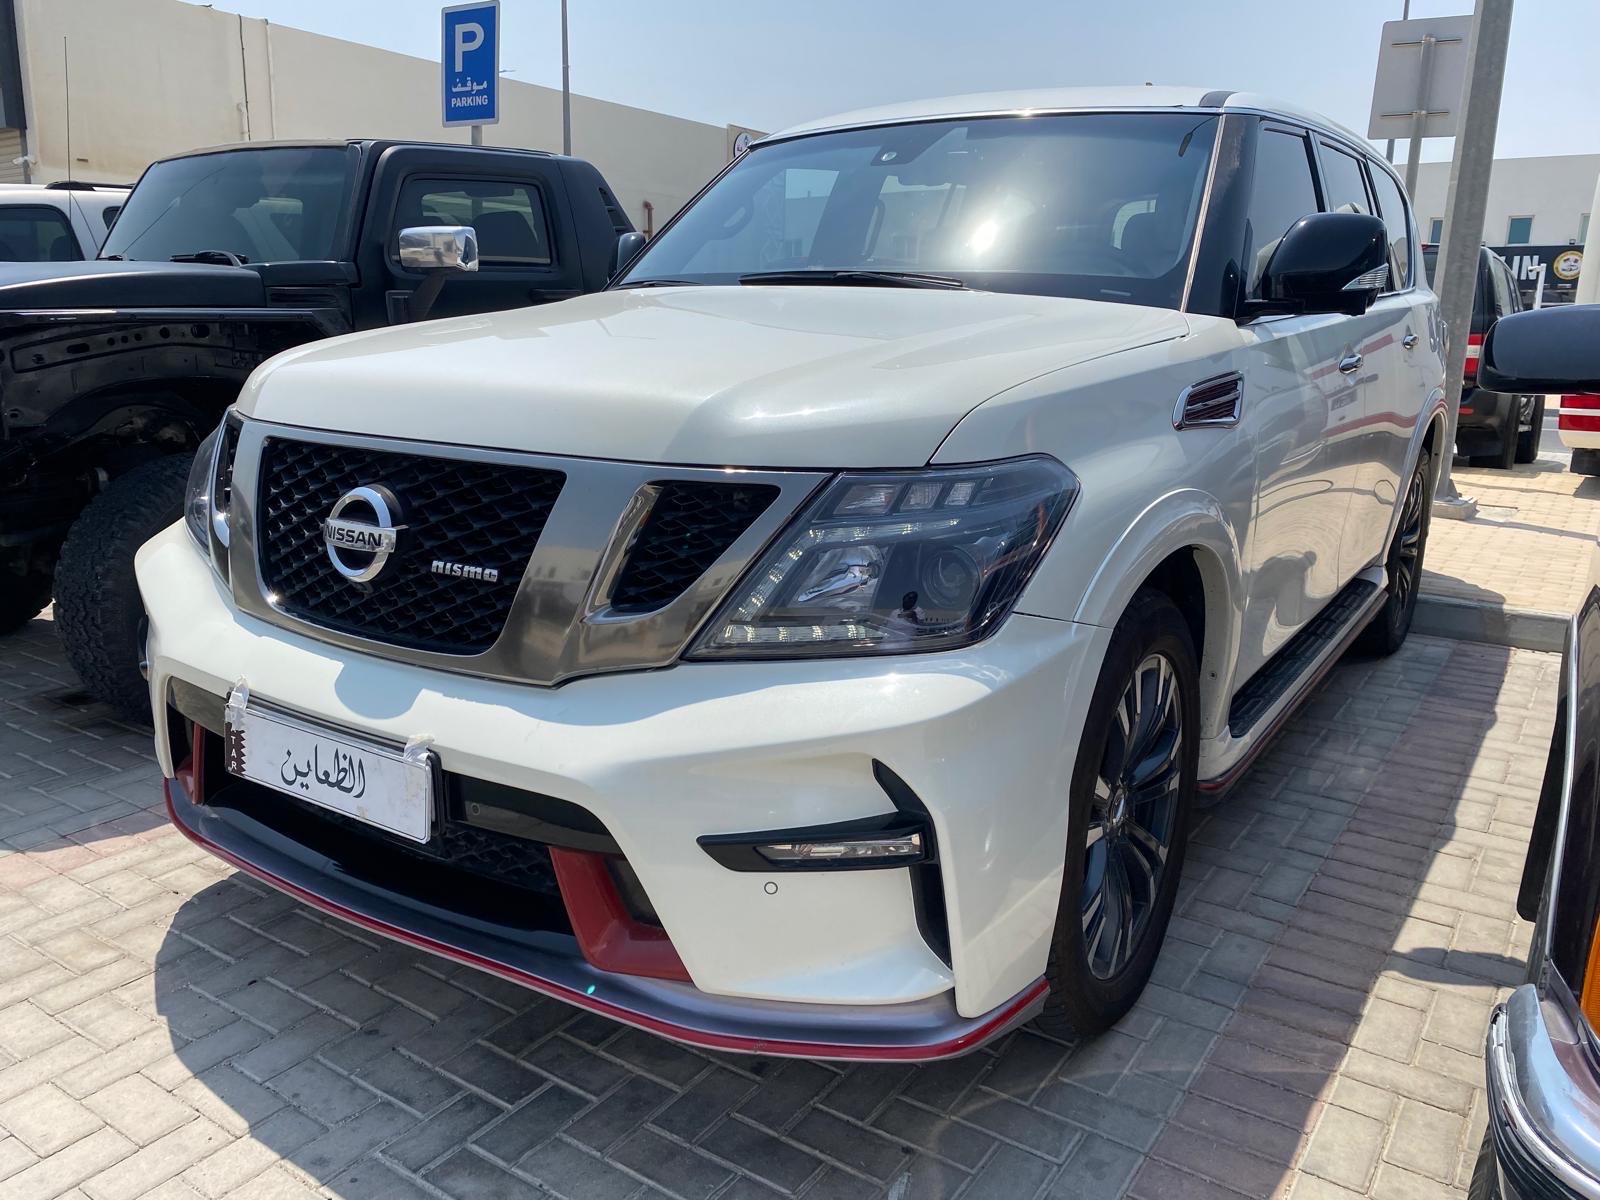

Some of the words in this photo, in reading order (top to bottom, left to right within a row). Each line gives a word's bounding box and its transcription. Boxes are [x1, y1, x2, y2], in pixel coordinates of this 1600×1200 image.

[455, 22, 485, 73] P
[451, 77, 488, 94] موقف
[451, 95, 488, 108] PARKING
[324, 526, 382, 548] NISSAN
[280, 744, 367, 799] الظعاين
